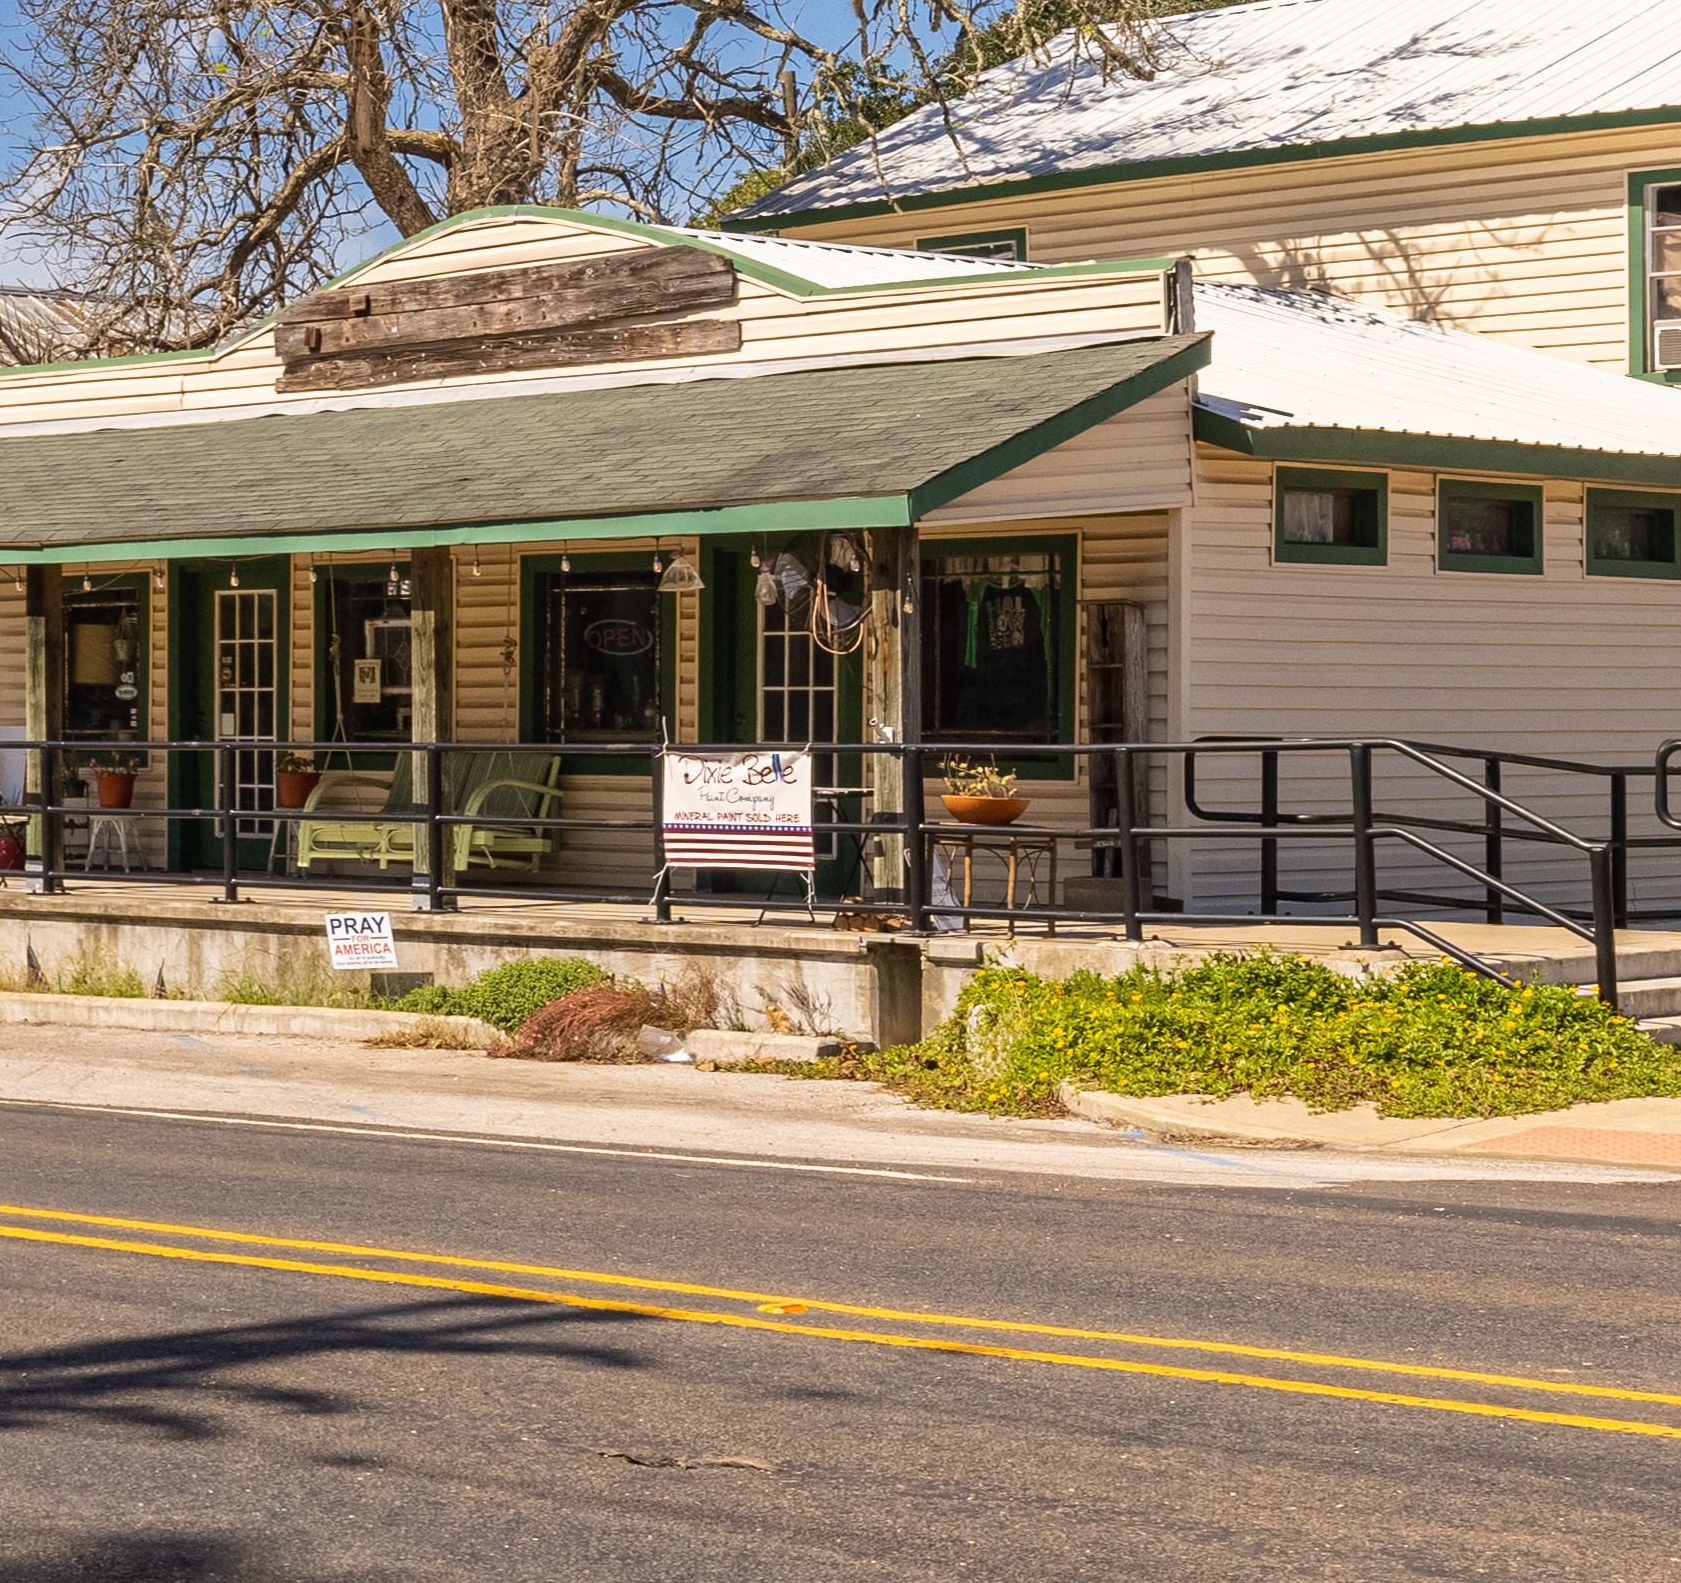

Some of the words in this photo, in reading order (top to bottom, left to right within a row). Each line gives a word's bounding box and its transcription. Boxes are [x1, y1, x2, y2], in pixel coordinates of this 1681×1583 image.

[588, 628, 645, 649] OPEN
[678, 754, 733, 785] Dixie
[697, 786, 725, 802] Paint
[726, 787, 775, 811] Company
[674, 812, 714, 821] MINERAL
[717, 813, 742, 822] PAINT
[746, 814, 771, 823] SOLD
[775, 814, 800, 823] HERE
[330, 916, 384, 935] PRAY
[335, 943, 391, 955] AMERICA
